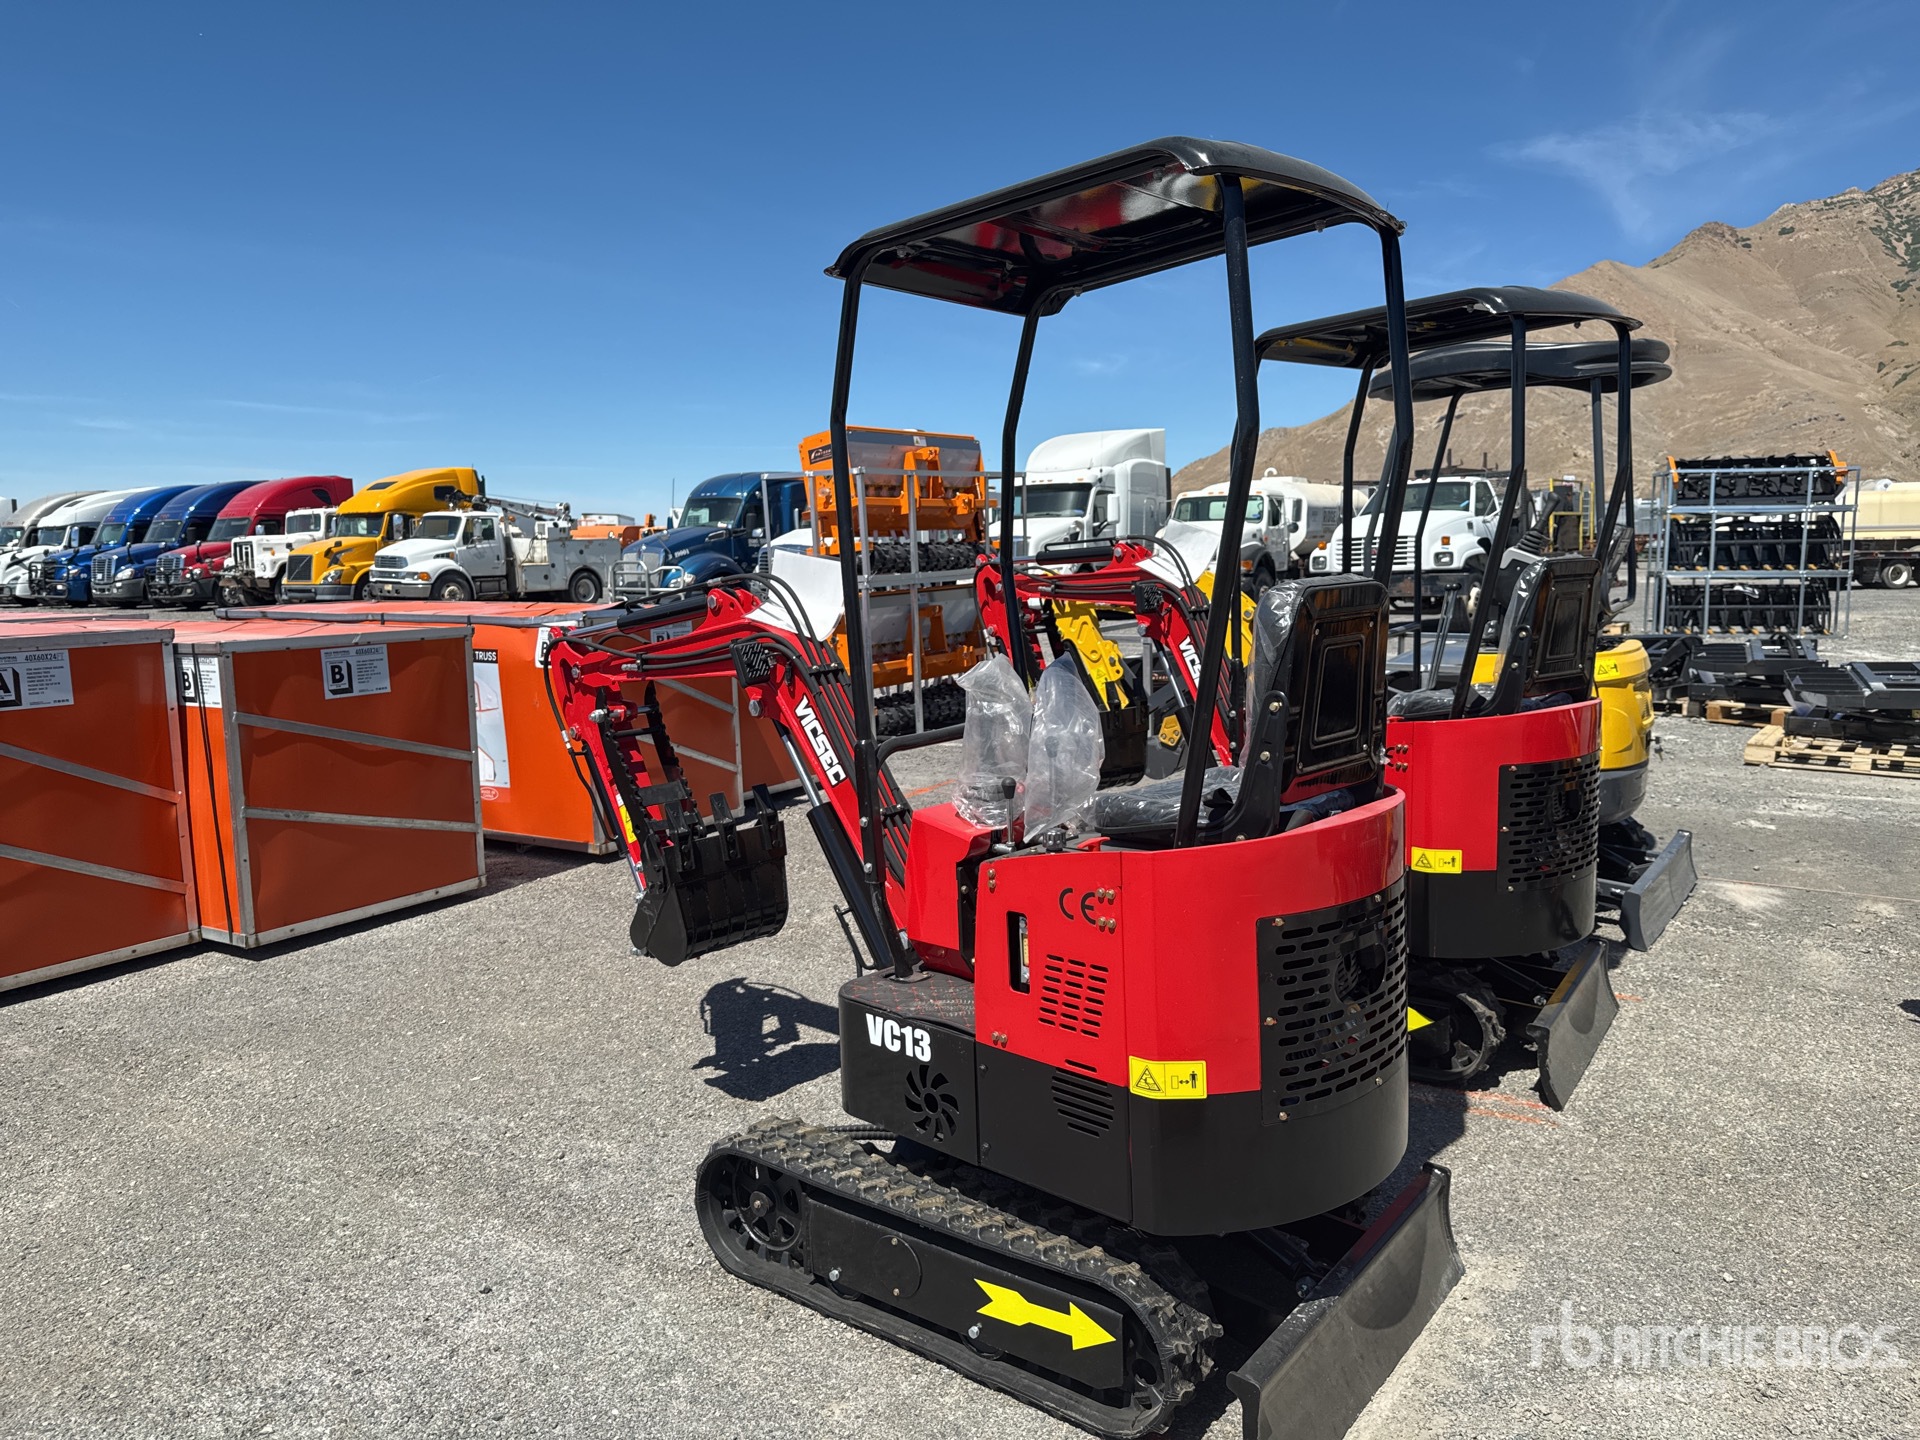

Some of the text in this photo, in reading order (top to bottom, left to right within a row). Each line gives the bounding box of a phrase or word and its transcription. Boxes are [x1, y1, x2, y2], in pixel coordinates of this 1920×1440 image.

[474, 651, 497, 661] TRUSS
[181, 671, 192, 691] B
[330, 664, 345, 684] B
[795, 694, 847, 786] VICSEC
[1058, 887, 1097, 927] CE
[865, 1012, 932, 1063] VC13
